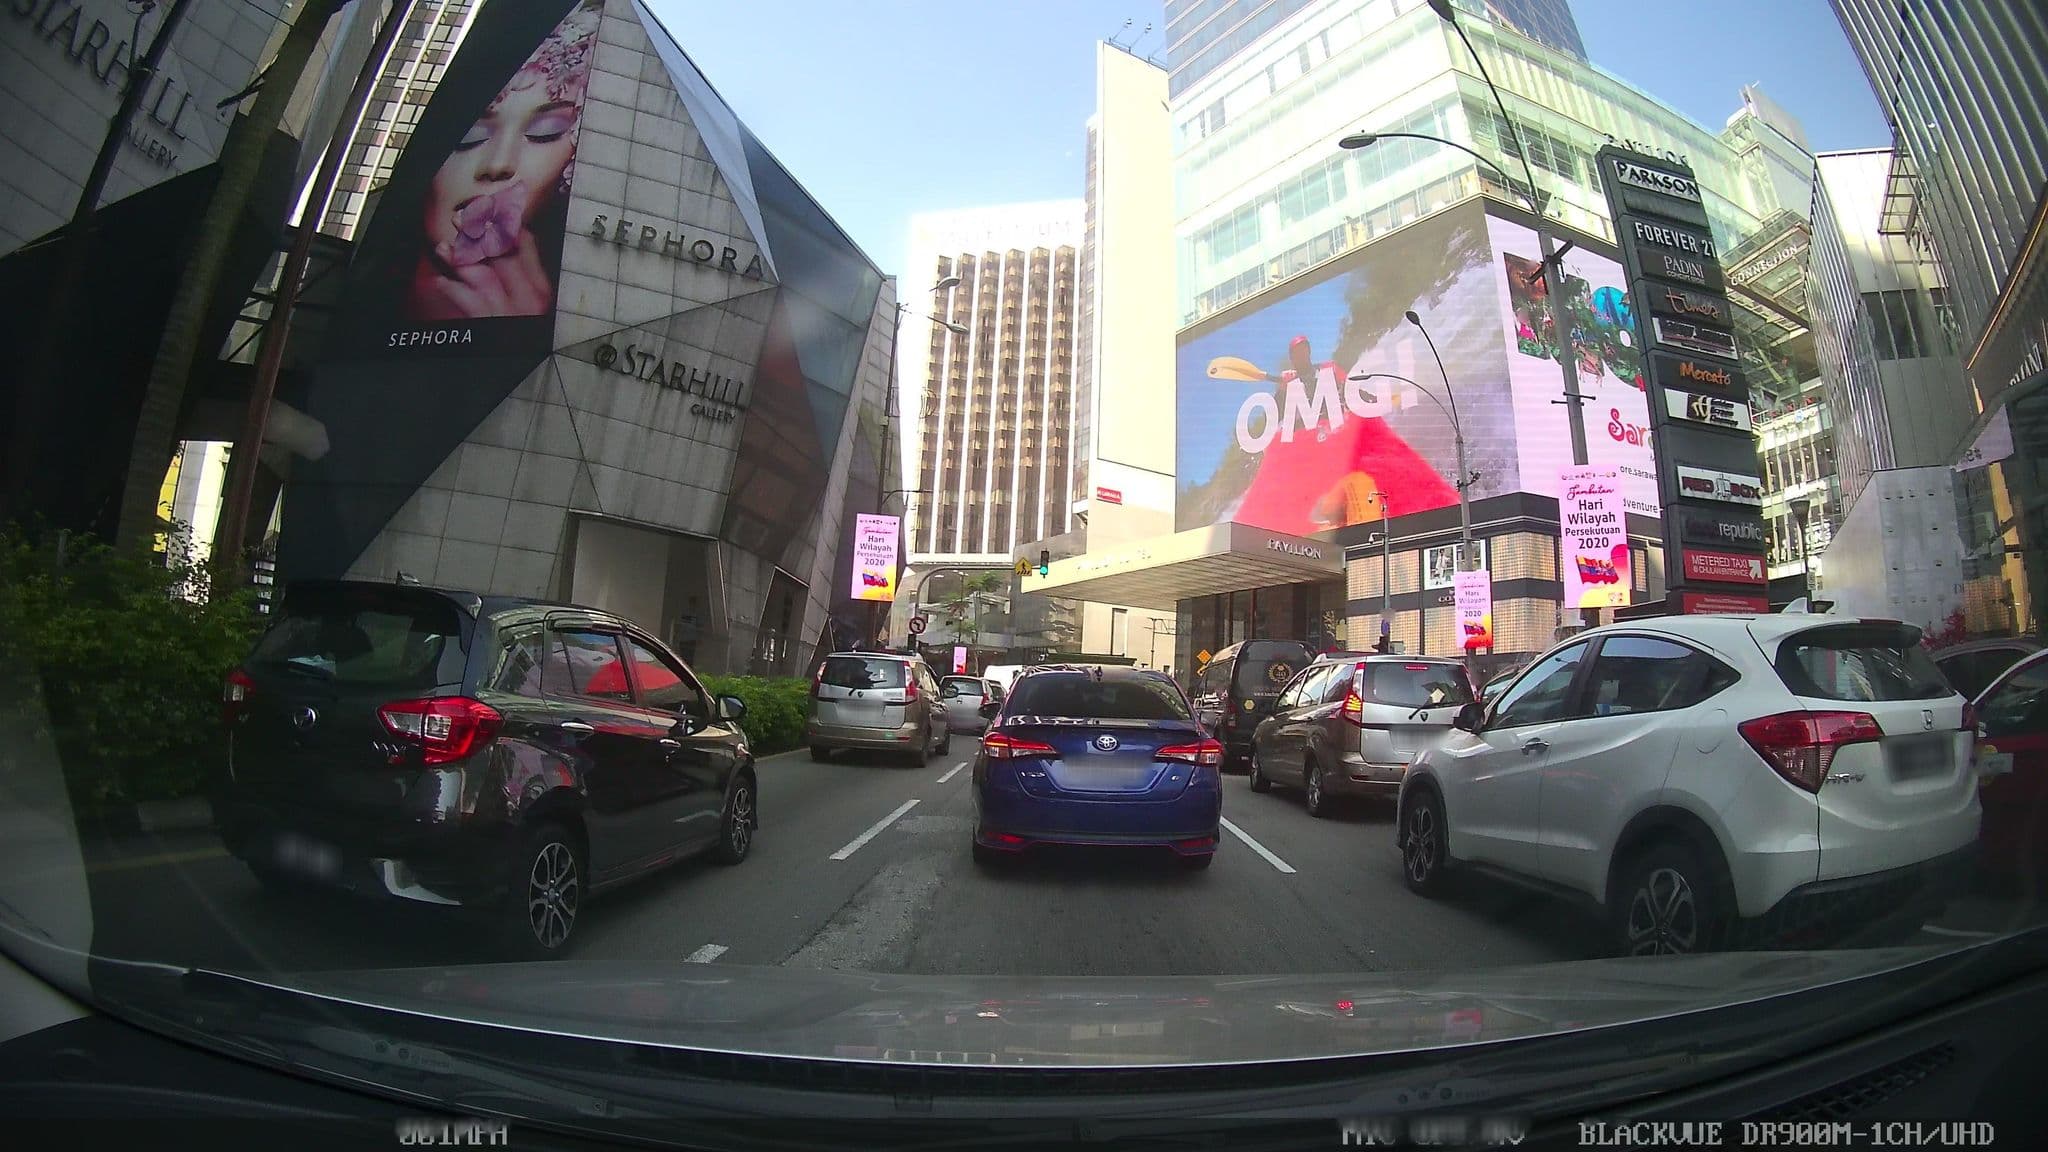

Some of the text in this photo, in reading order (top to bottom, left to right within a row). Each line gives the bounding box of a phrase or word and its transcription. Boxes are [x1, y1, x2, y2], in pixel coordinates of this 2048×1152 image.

[1616, 160, 1700, 196] PARKSON
[591, 214, 764, 281] SEPHORA
[1635, 221, 1717, 258] FOREVER 21
[1664, 255, 1705, 279] PADINI
[1731, 244, 1797, 286] CONNECTION
[388, 328, 473, 347] SEPHORA
[1236, 345, 1419, 453] OMG!
[690, 403, 736, 426] GALLERY
[1578, 499, 1603, 511] Hari
[1567, 512, 1616, 527] Wilayah
[1565, 526, 1621, 537] Persekutuan
[1718, 522, 1762, 542] republic
[860, 543, 892, 553] Wilayah
[1266, 538, 1321, 560] PAVILION
[1578, 536, 1609, 550] 2020
[864, 558, 886, 566] 2020
[1691, 554, 1748, 569] METERED TAXI
[1464, 610, 1482, 618] 2020
